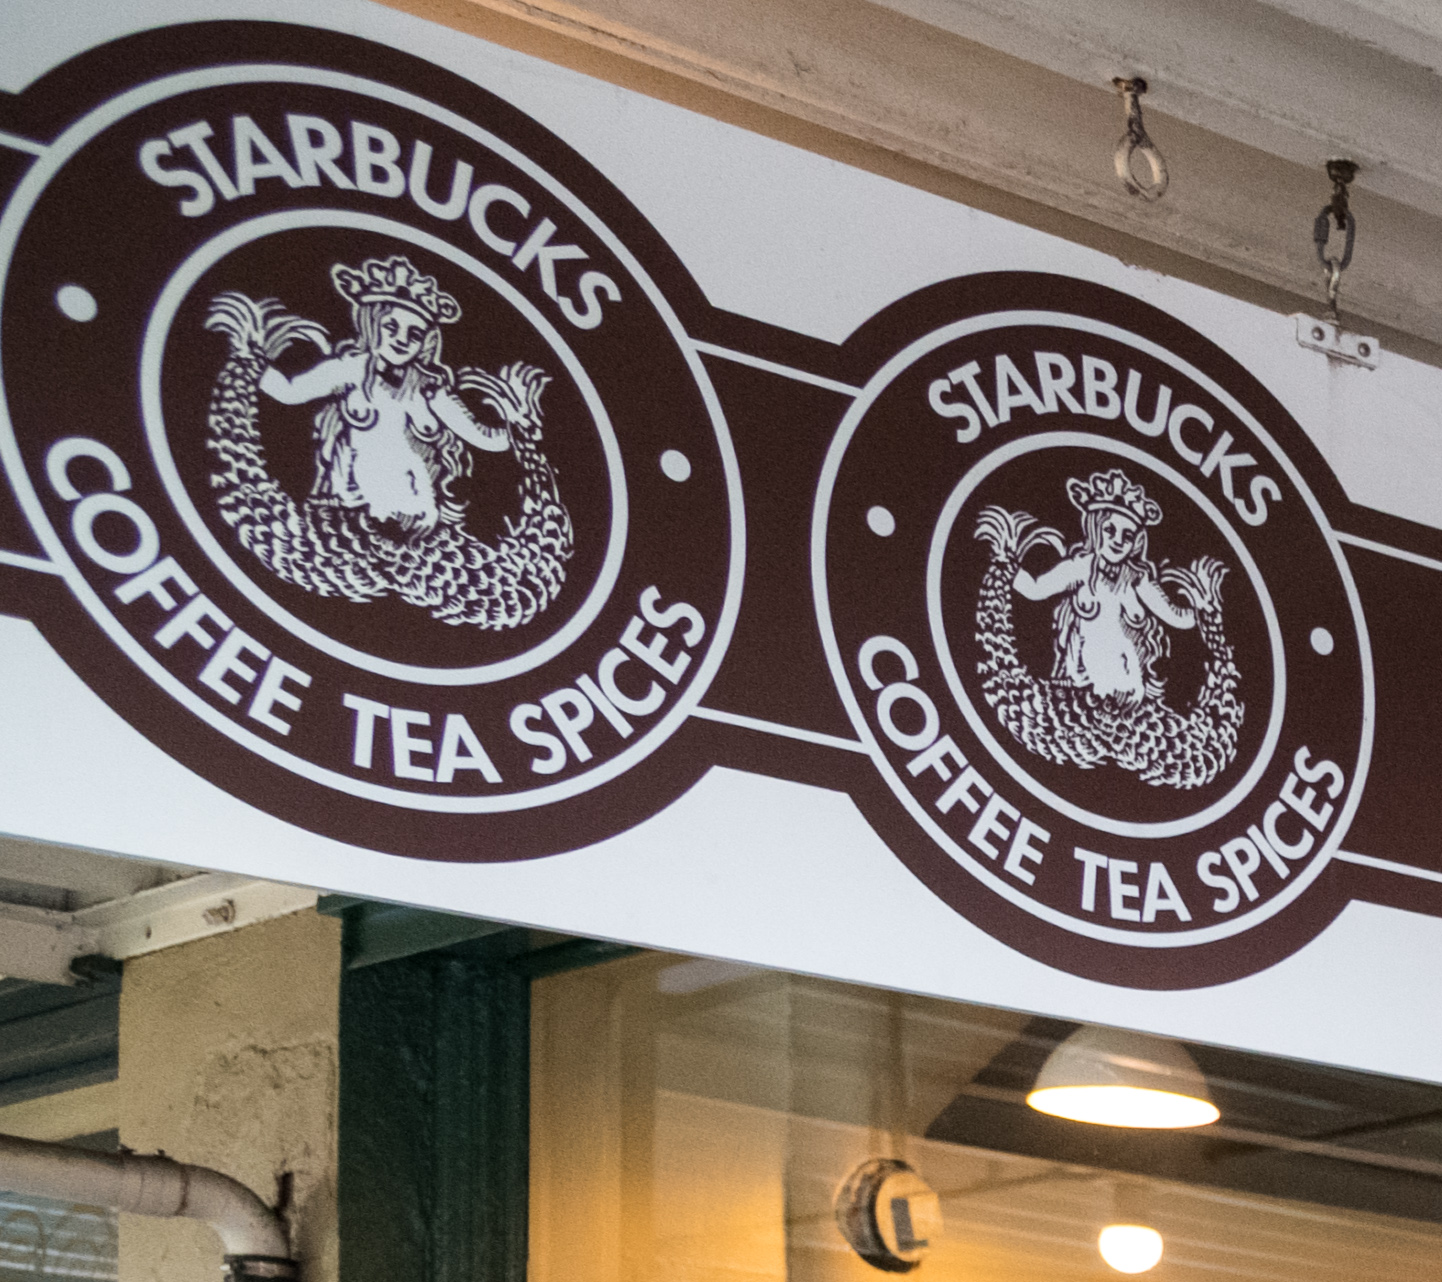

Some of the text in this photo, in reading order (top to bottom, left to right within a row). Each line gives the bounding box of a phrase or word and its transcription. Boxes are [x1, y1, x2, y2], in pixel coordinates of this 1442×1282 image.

[138, 112, 623, 331] STARBUCKS
[927, 349, 1282, 528] STARBUCKS
[43, 435, 706, 785] COFFEE TEA SPICES
[857, 633, 1345, 925] COFFEE TEA SPICES
